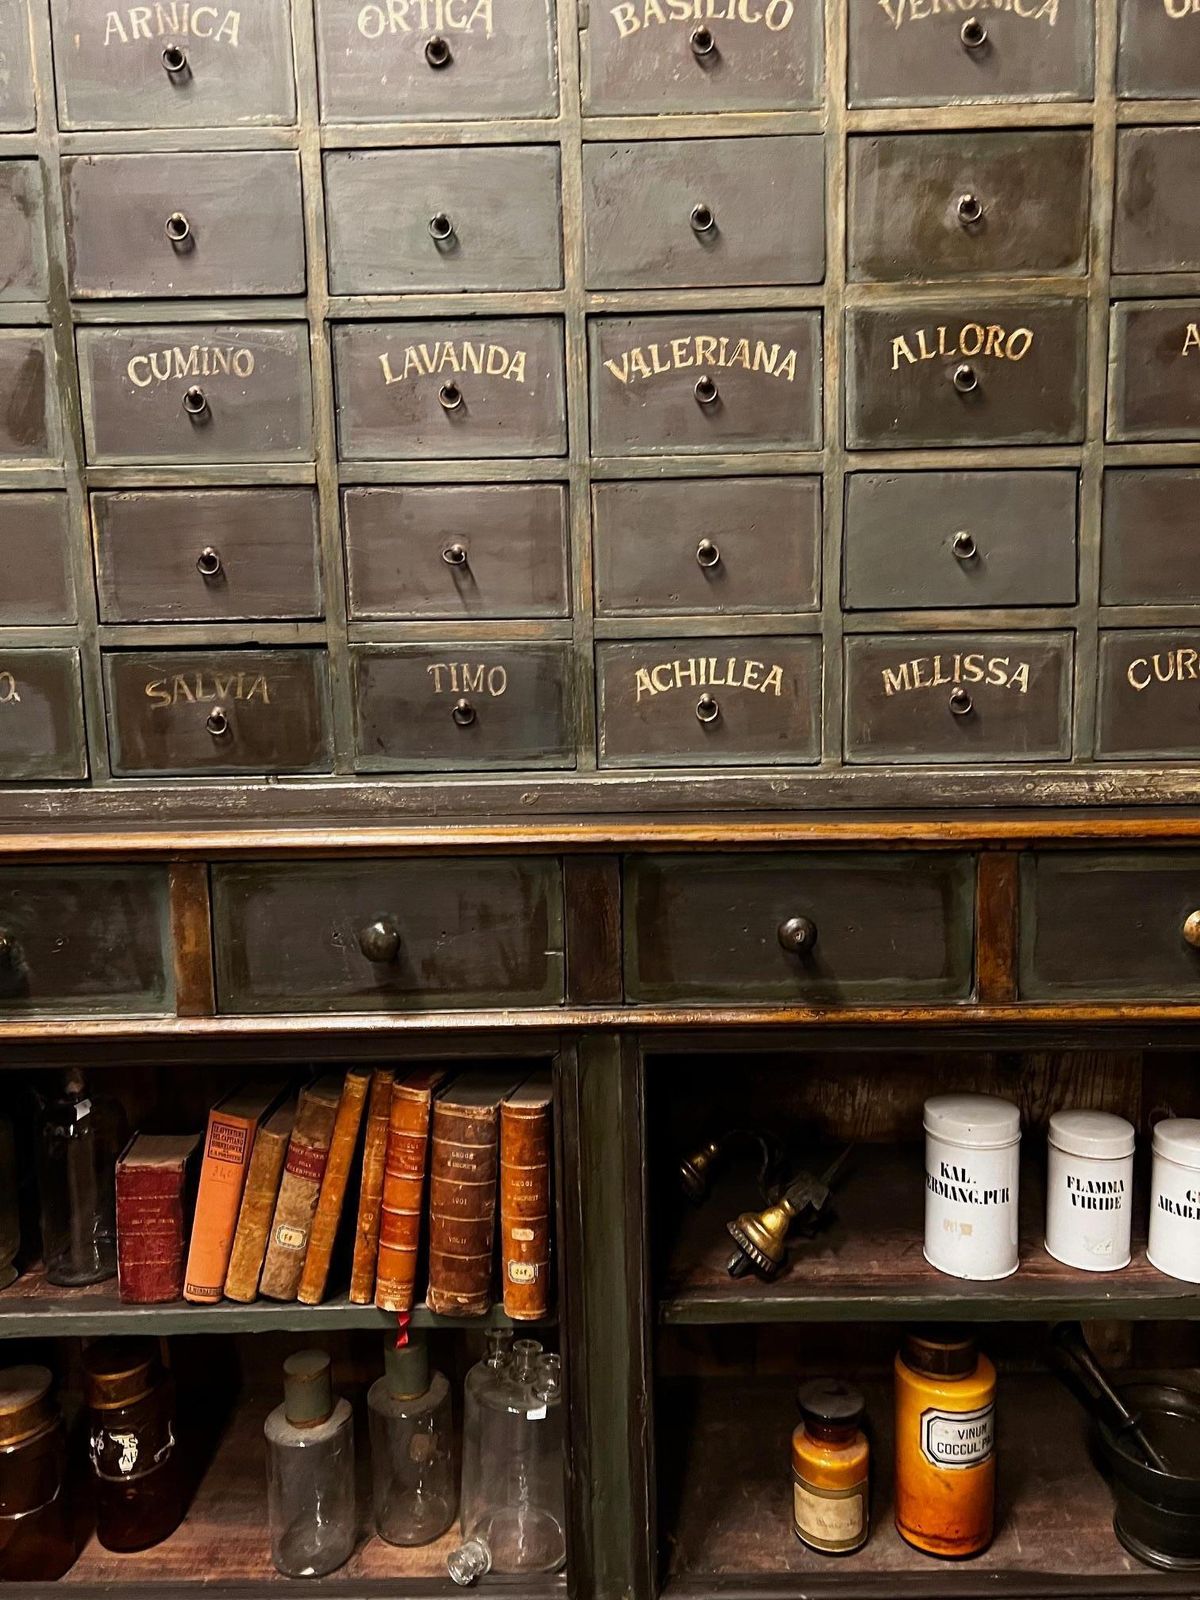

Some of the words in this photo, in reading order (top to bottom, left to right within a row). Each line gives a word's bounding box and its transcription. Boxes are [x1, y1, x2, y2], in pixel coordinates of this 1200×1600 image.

[103, 2, 241, 48] ARNICA
[357, 0, 495, 40] ORTICA
[610, 0, 794, 38] BASILICO
[878, 0, 1059, 31] VECA
[127, 345, 255, 387] CUMINO
[378, 341, 527, 385] LAVANDA
[603, 335, 797, 384] VALERIANA
[890, 323, 1034, 370] ALLORO
[145, 671, 270, 709] SALVIA
[427, 662, 507, 697] TIMO
[634, 658, 783, 702] ACHILLEA
[881, 653, 1031, 697] MELISSA
[926, 1173, 1010, 1206] ERMANG.PUR
[1066, 1175, 1125, 1194] FLAMMA
[1071, 1193, 1122, 1211] VIRIDE
